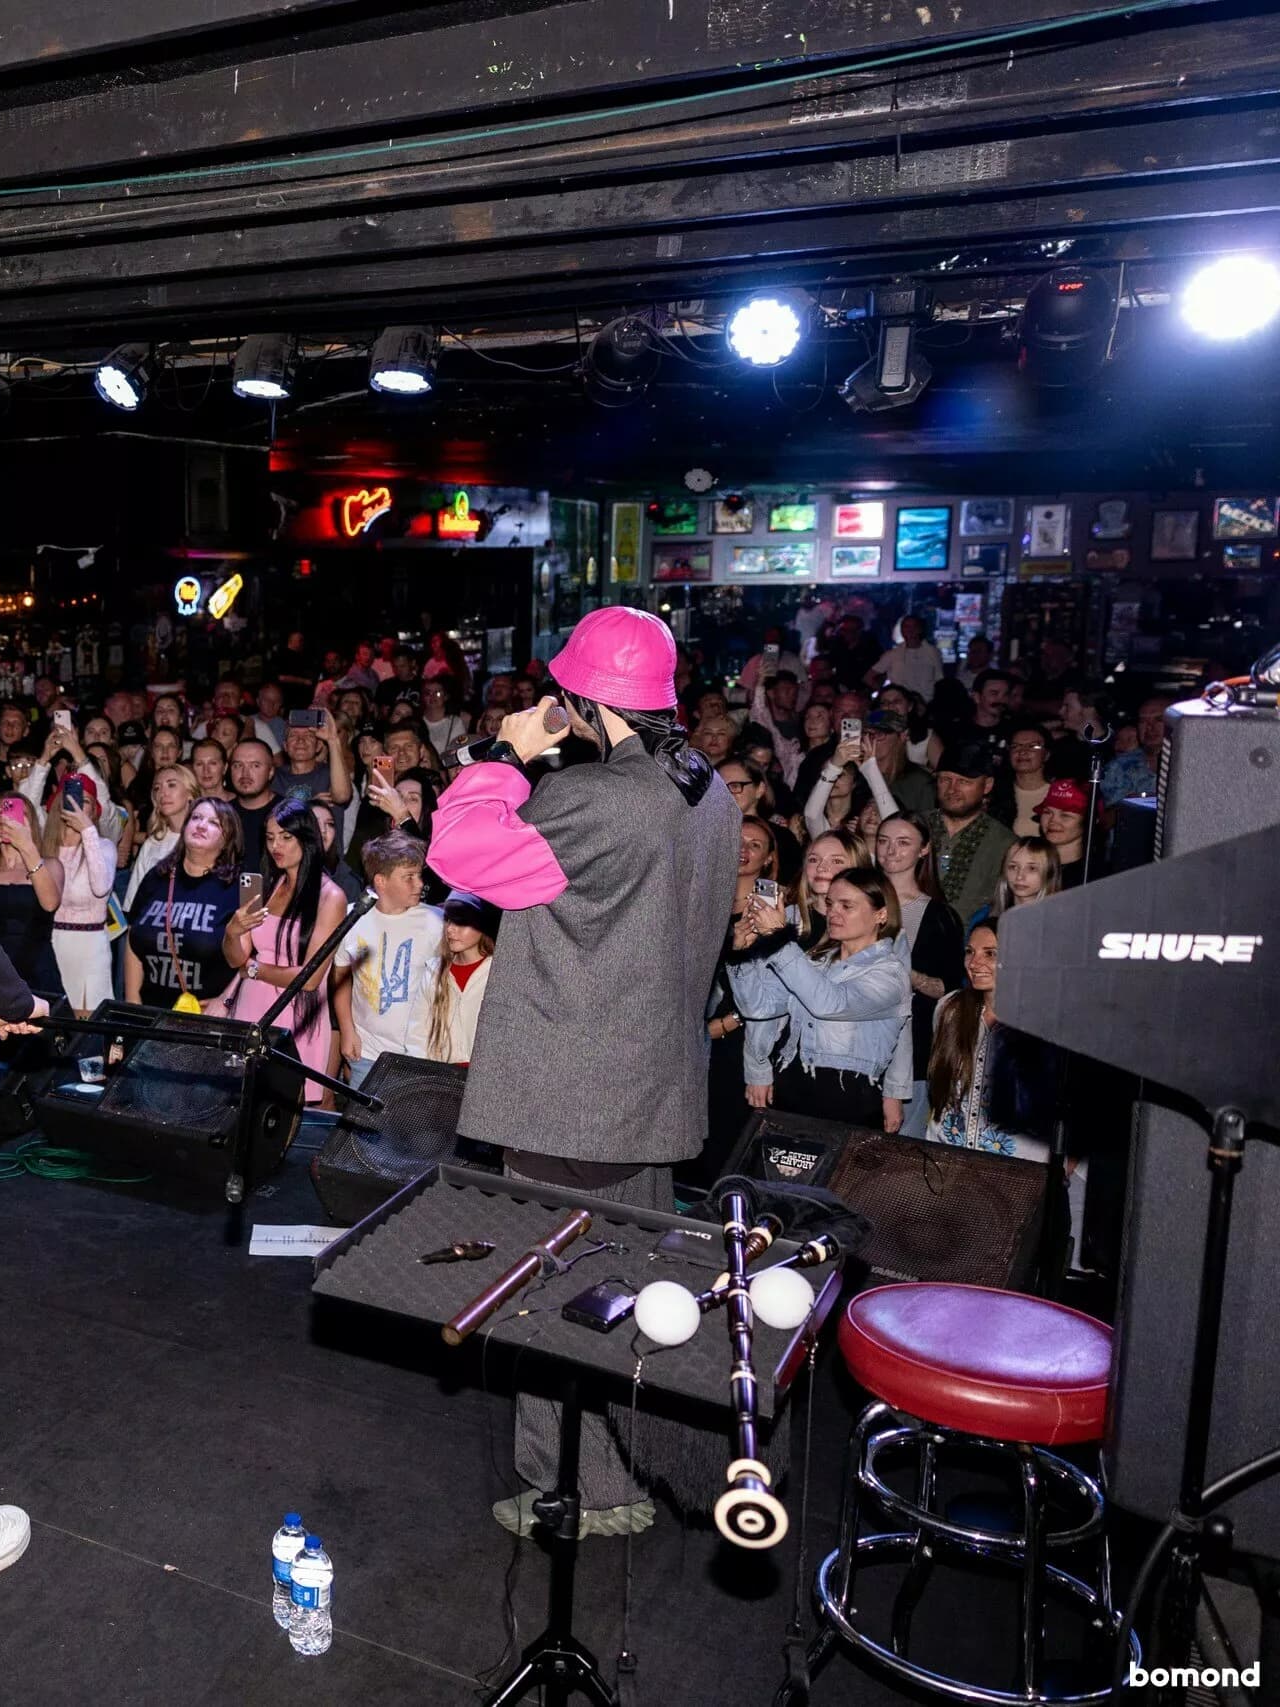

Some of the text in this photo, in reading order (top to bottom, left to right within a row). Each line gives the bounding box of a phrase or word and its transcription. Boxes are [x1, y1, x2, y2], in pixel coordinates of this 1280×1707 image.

[139, 901, 217, 932] PEOPLE
[156, 932, 184, 954] OF
[1098, 932, 1257, 965] SHURE
[145, 955, 203, 990] STEEL
